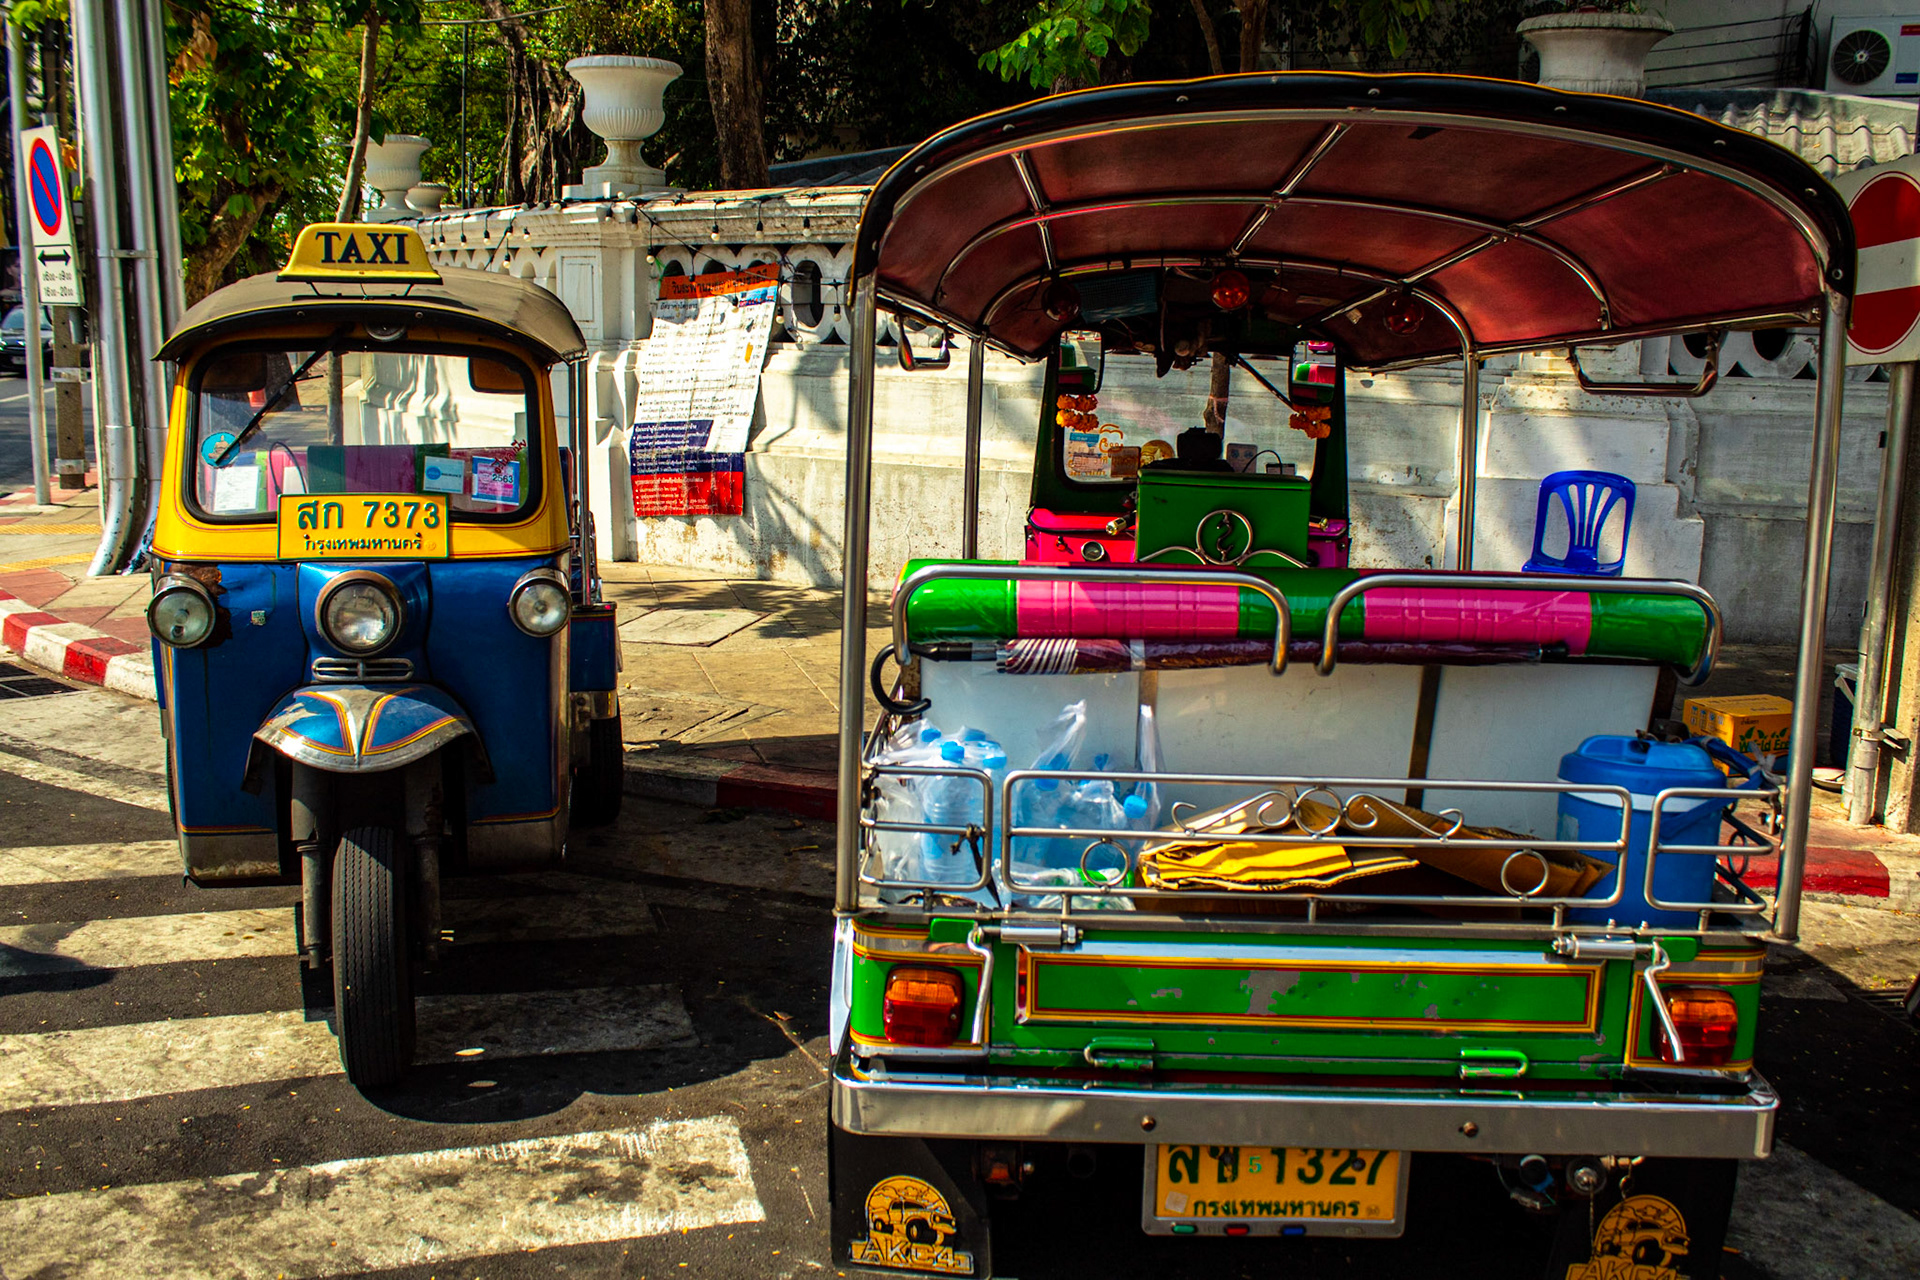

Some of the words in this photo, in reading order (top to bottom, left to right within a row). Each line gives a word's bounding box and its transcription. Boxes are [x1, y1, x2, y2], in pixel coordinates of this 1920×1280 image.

[315, 232, 410, 264] TAXI
[492, 473, 514, 483] 2563
[297, 500, 343, 529] สก
[363, 501, 440, 529] 7373
[305, 536, 422, 555] กรุงเทพมหานคร
[1270, 1148, 1391, 1186] 1327
[1193, 1199, 1361, 1217] กรงเทพมหานคร
